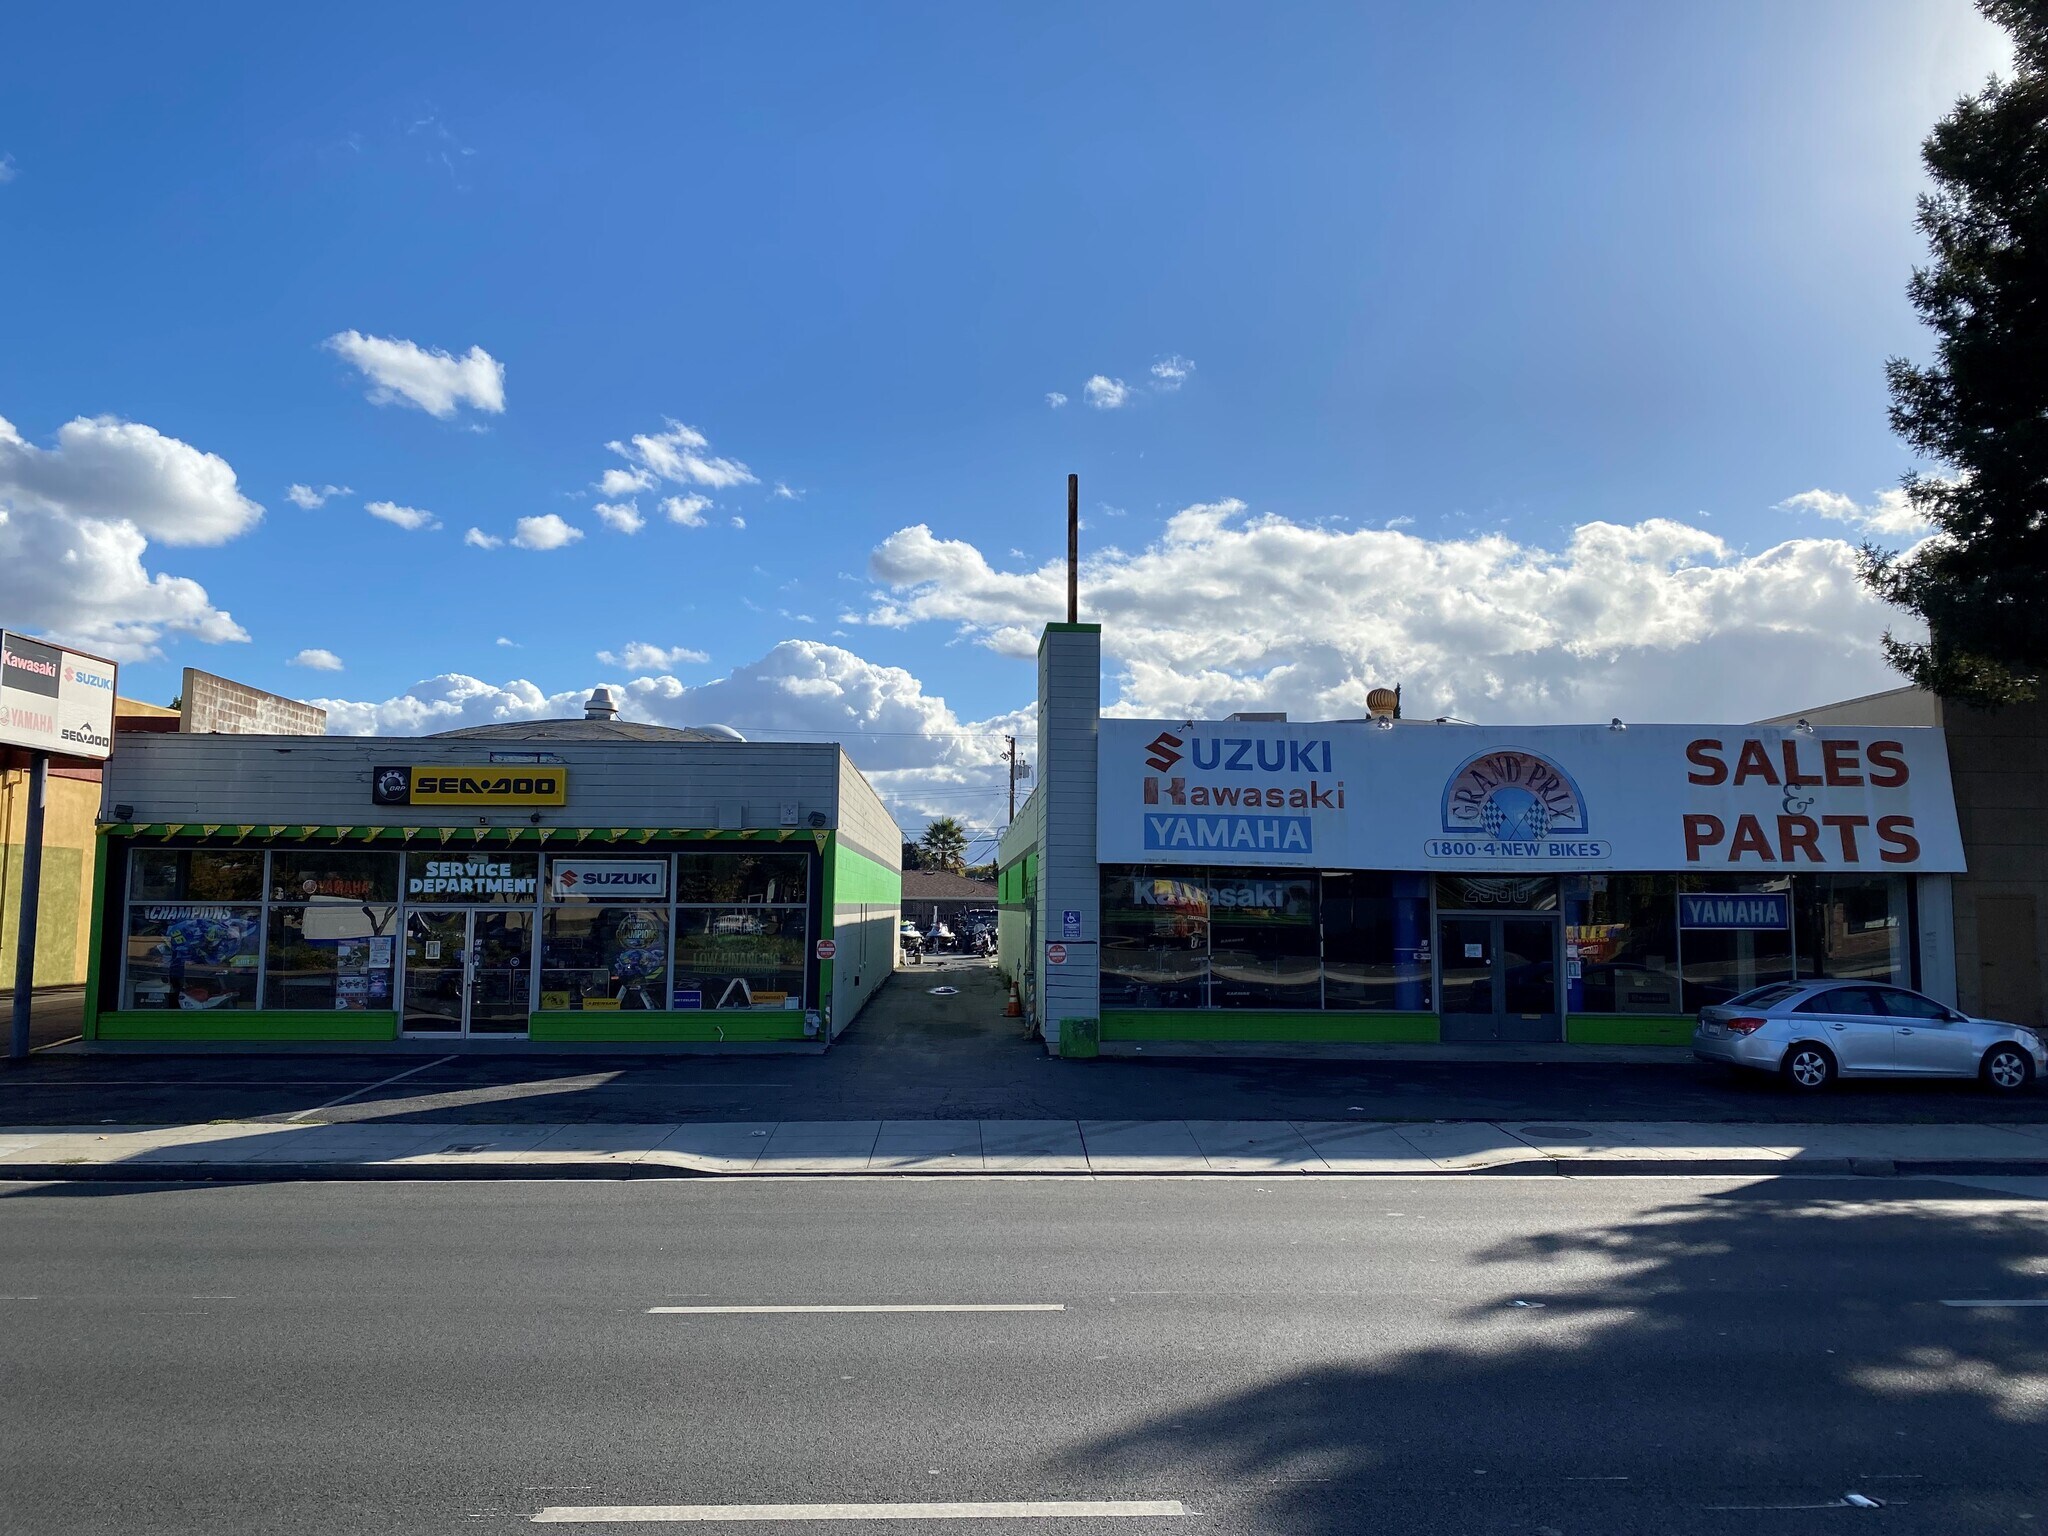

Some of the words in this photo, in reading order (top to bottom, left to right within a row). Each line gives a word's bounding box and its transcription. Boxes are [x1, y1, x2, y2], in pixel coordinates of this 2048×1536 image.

[3, 649, 57, 677] Kawasaki
[75, 671, 113, 691] SUZUKI
[11, 707, 54, 734] YAMAHA
[1144, 731, 1333, 773] SUZUKI
[1685, 738, 1910, 788] SALES
[389, 784, 407, 792] BRP
[1143, 776, 1345, 809] Kawasaki
[1452, 754, 1522, 821] GRAND
[1525, 762, 1576, 822] PRIX
[1782, 782, 1815, 816] &
[1149, 816, 1308, 850] YAMAHA
[1682, 813, 1921, 864] PARTS
[1549, 843, 1601, 857] BIKES
[426, 861, 512, 878] SERVICE
[582, 872, 658, 886] SUZUKI
[317, 879, 370, 893] YAMAHA
[409, 878, 537, 894] DEPARTMENT
[1687, 900, 1780, 923] YAMAHA
